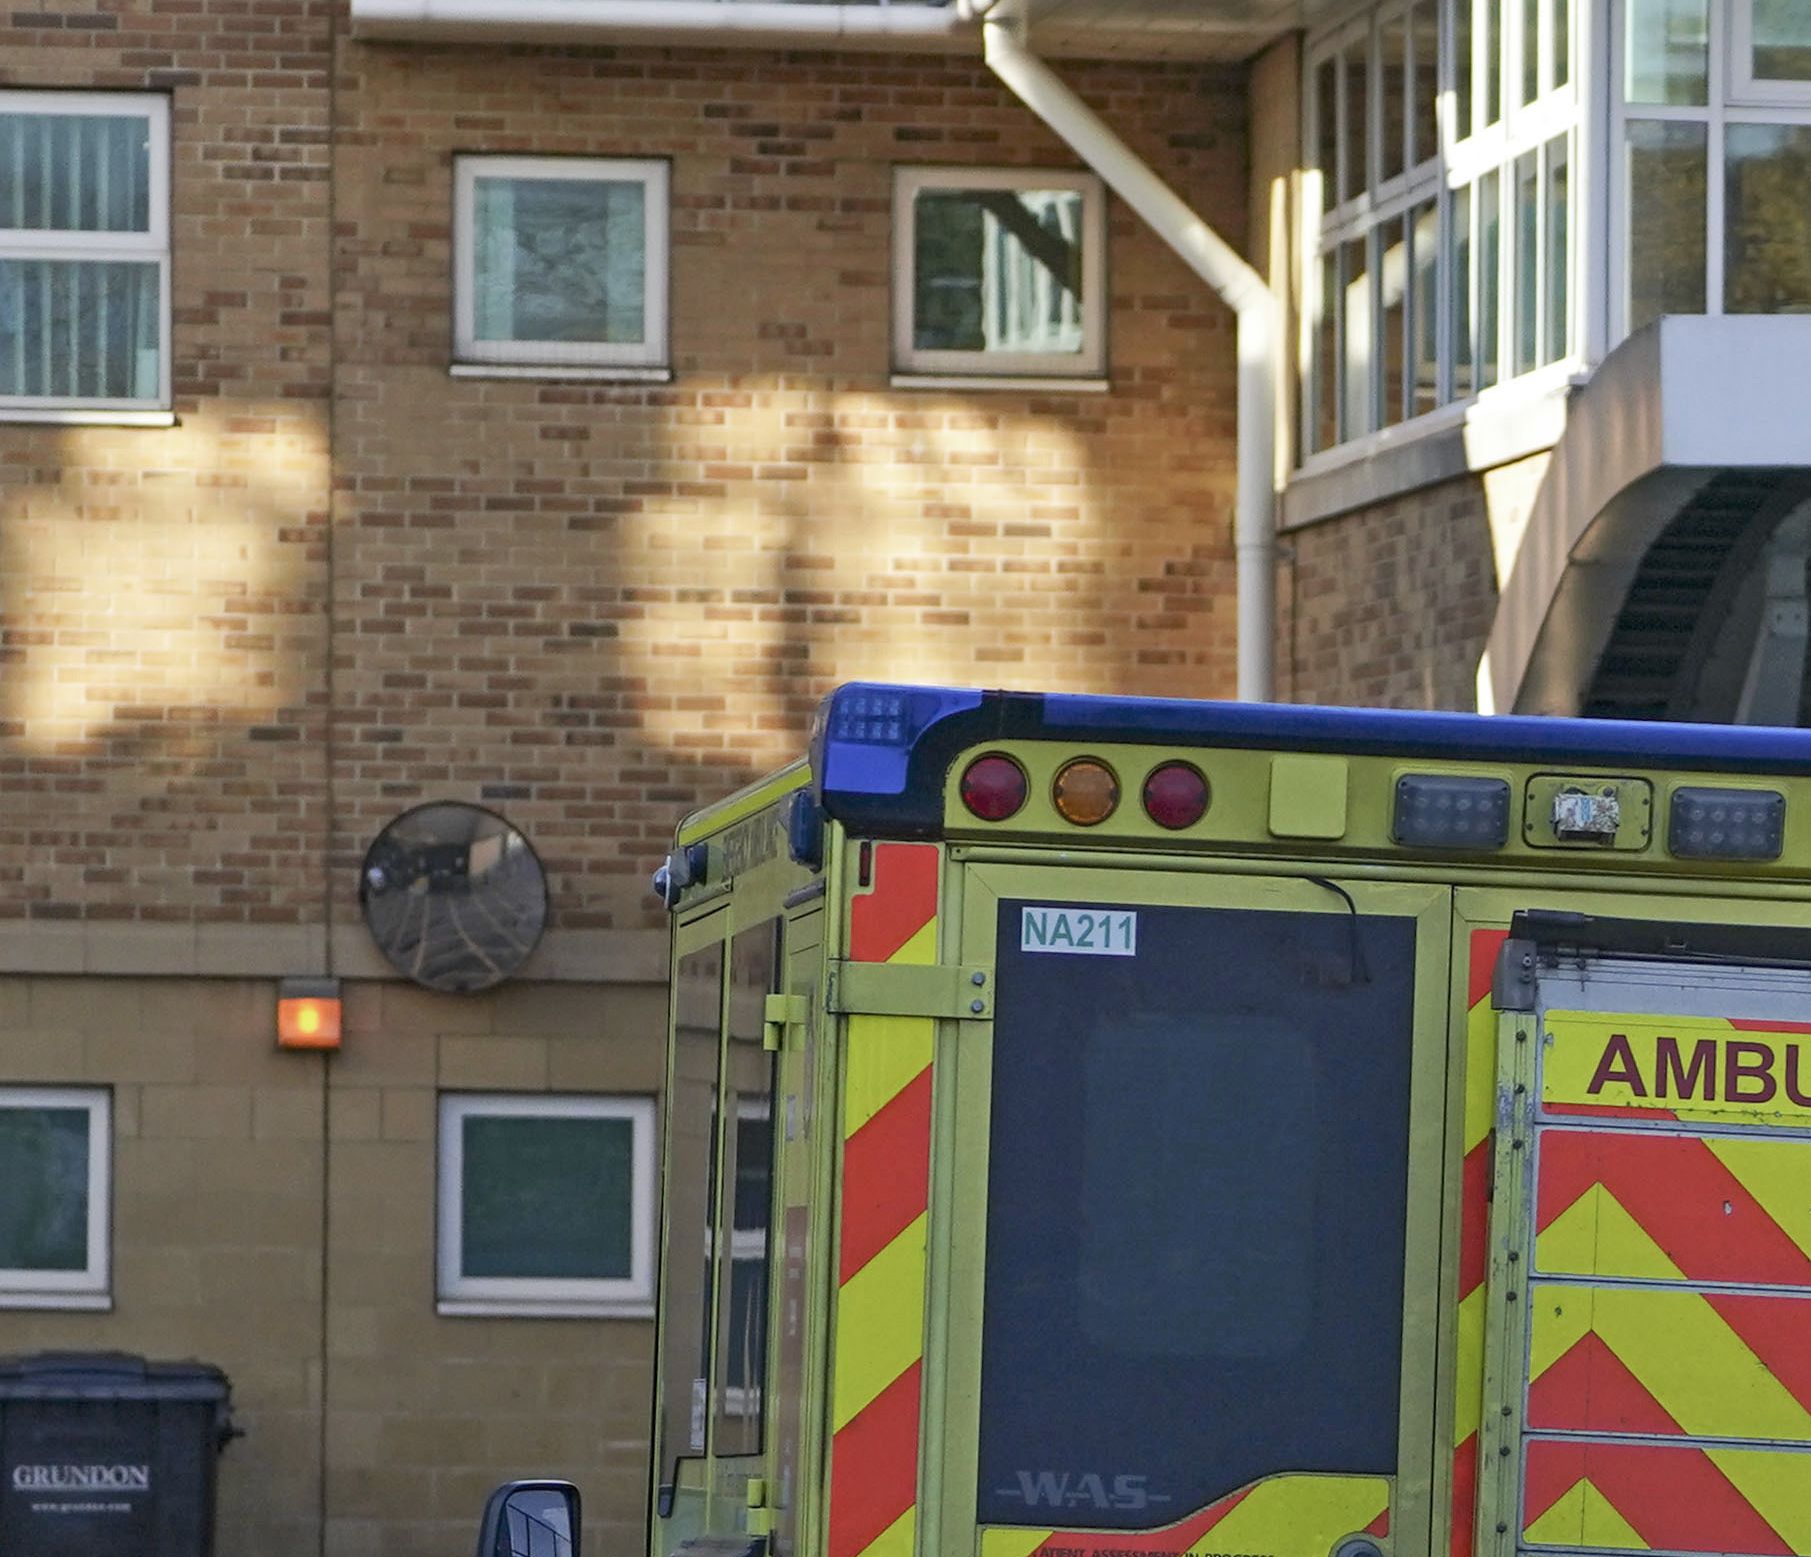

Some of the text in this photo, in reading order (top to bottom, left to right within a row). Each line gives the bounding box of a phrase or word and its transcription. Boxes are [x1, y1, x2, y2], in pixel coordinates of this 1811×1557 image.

[1023, 910, 1132, 950] NA211
[12, 1464, 150, 1488] GRUNDON
[1015, 1469, 1148, 1510] WAS
